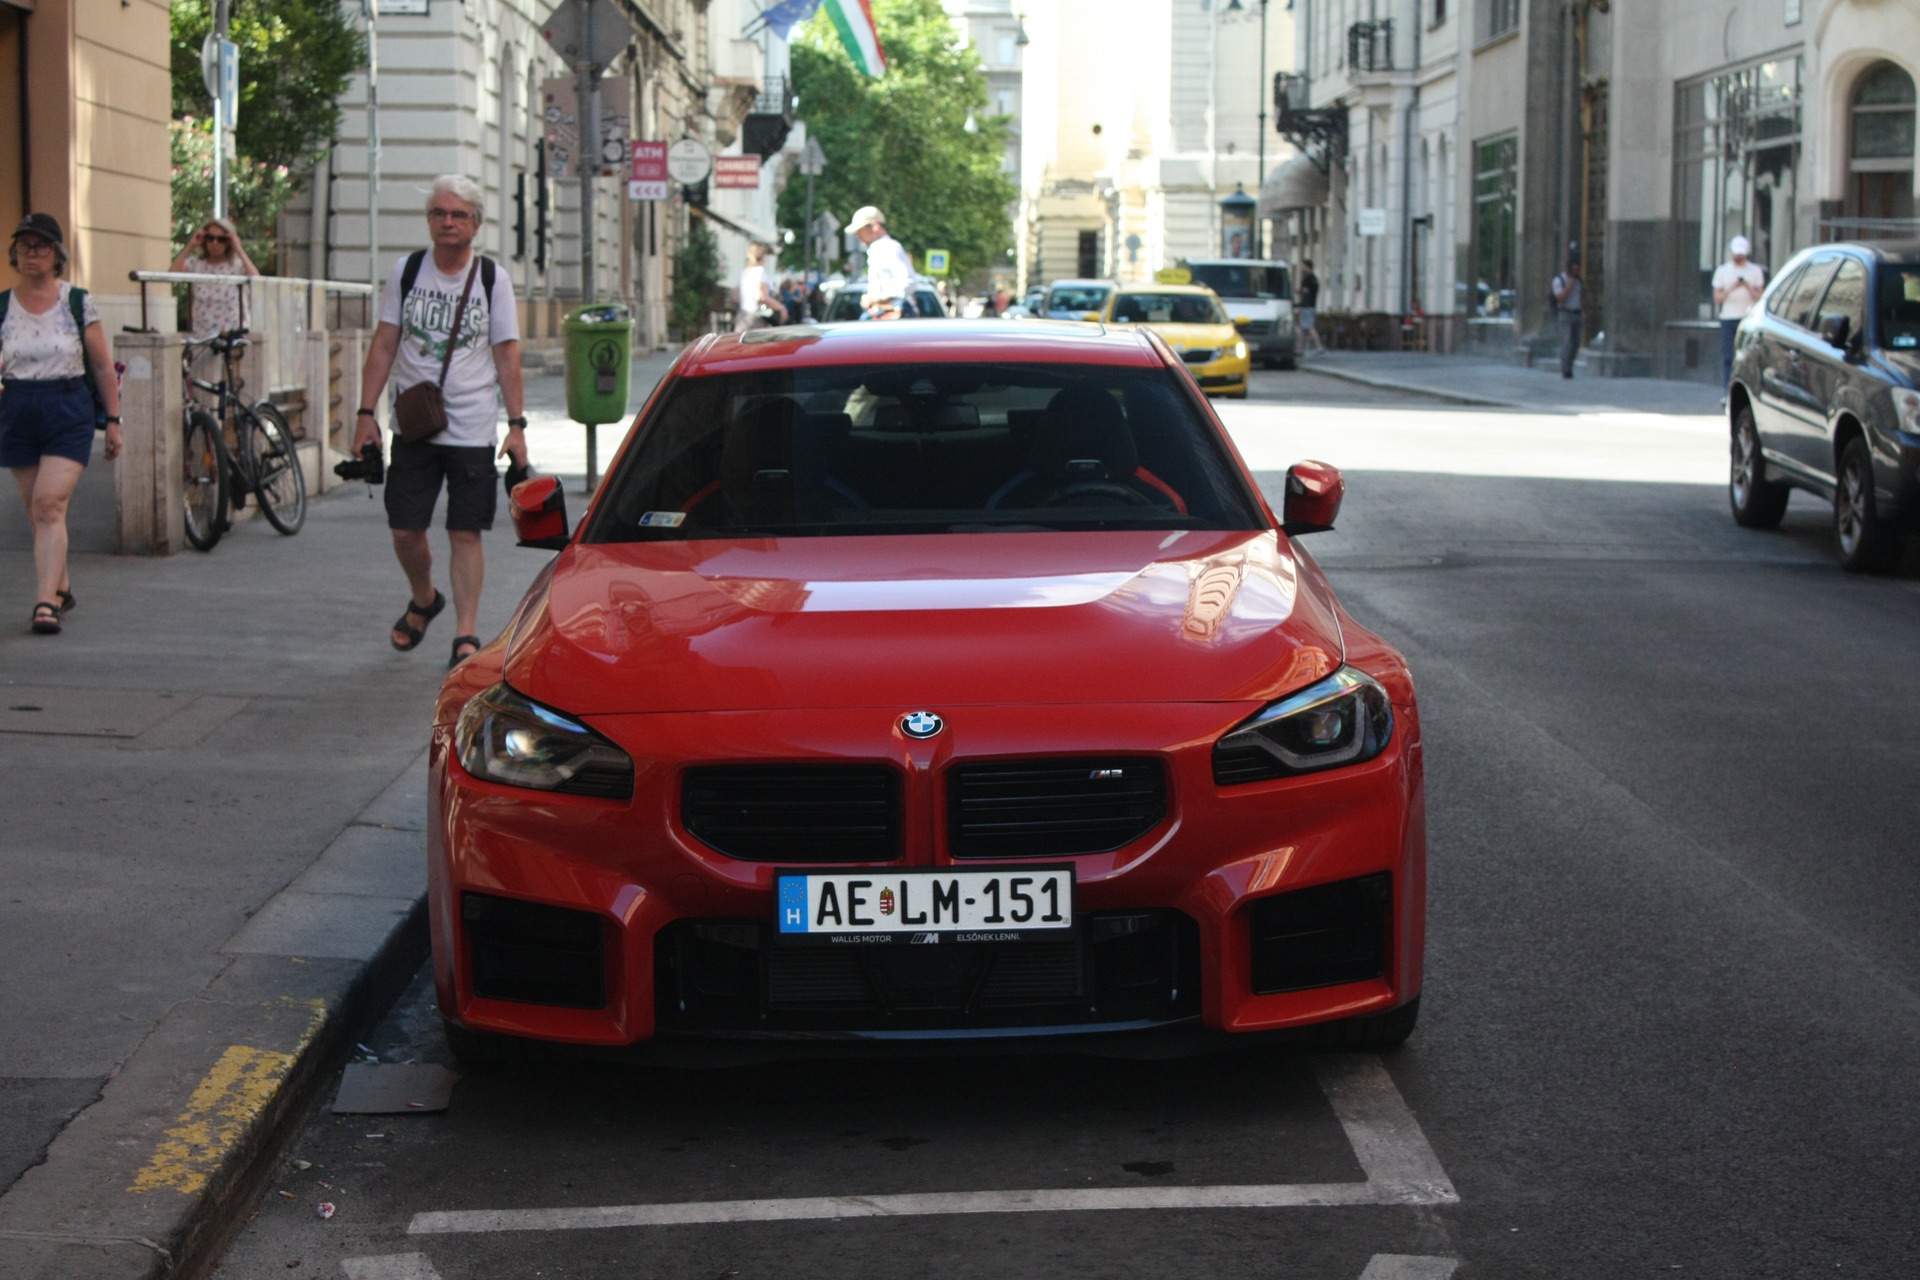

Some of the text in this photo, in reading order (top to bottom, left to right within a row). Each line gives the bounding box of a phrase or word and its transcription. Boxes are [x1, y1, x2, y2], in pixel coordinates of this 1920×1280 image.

[635, 146, 663, 160] ATM
[718, 161, 758, 170] CHINESE
[816, 877, 1063, 926] AE LM-151
[786, 908, 801, 925] H
[831, 935, 892, 943] WALLIS MOTOR
[957, 933, 994, 942] ELSŐNEK
